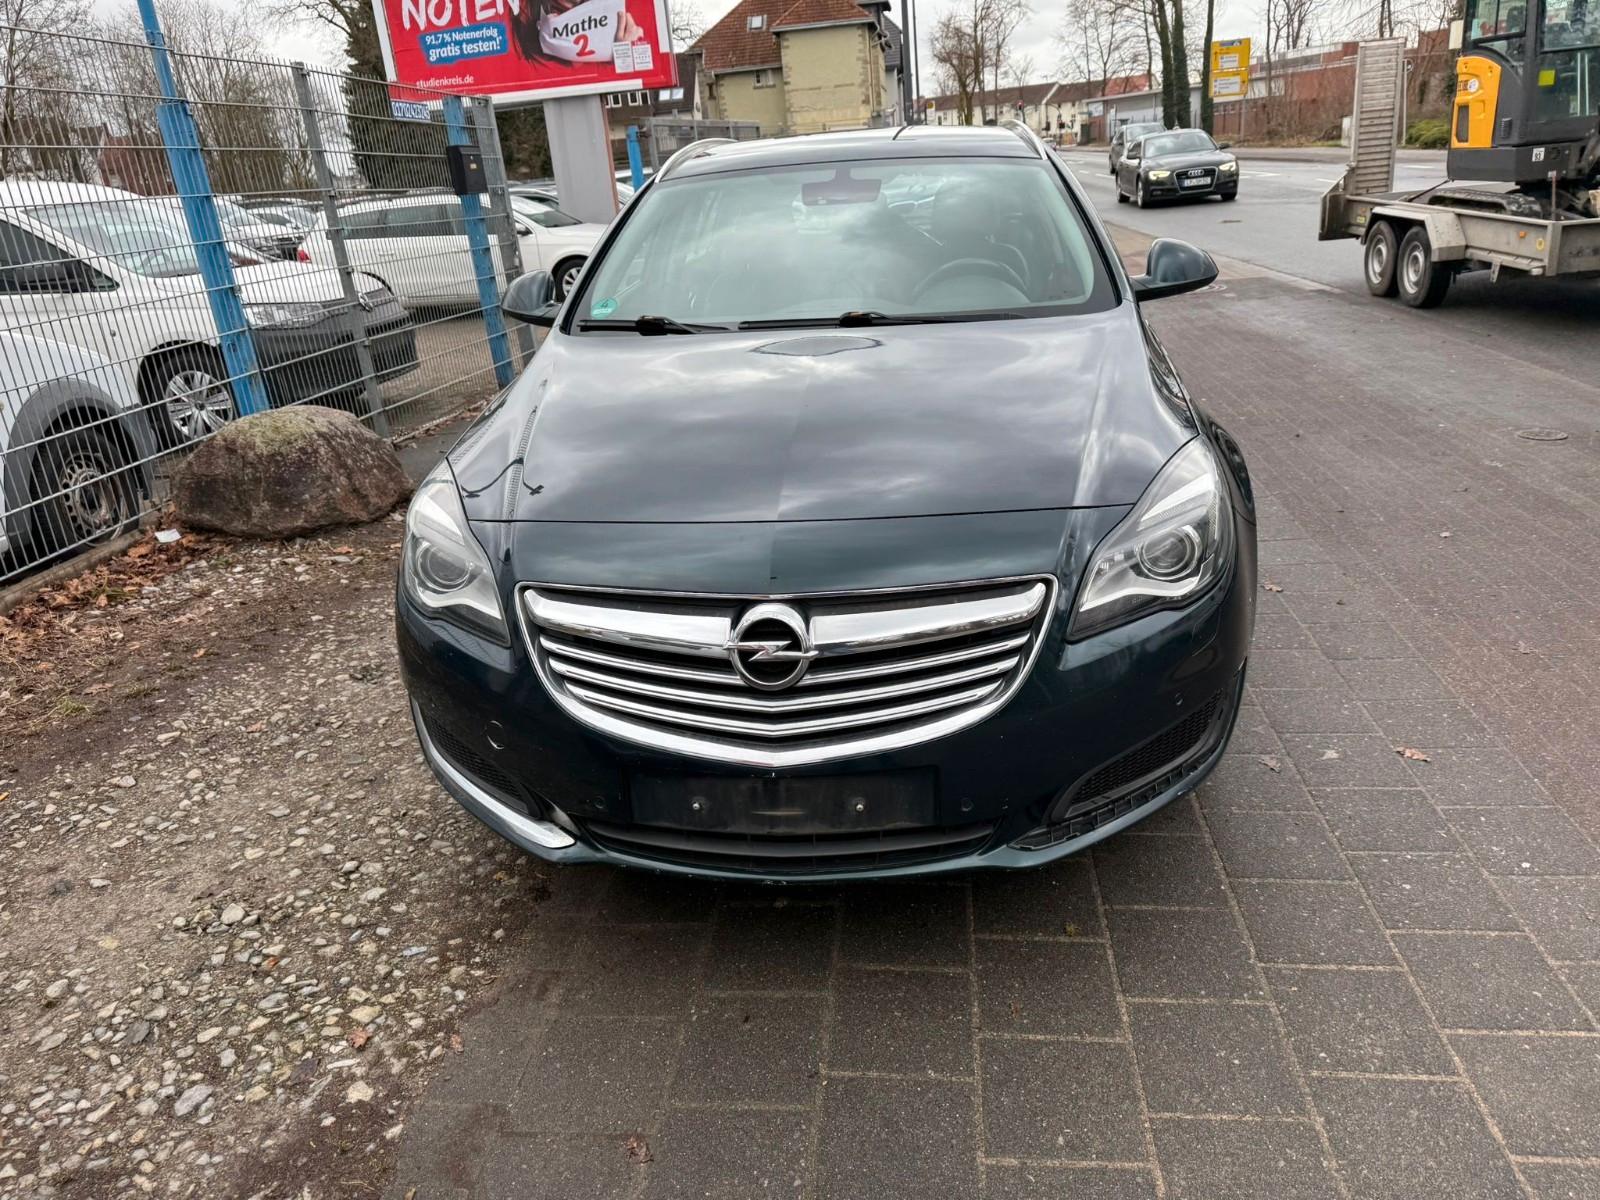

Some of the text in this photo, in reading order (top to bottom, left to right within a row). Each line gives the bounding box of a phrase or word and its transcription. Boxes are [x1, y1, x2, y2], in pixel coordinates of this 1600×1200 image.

[425, 34, 442, 46] 91,7
[452, 26, 498, 41] Notenerfolg
[552, 15, 608, 38] Mathe
[429, 44, 460, 61] gratis
[573, 34, 596, 57] 2
[416, 74, 474, 88] studienkreis.de
